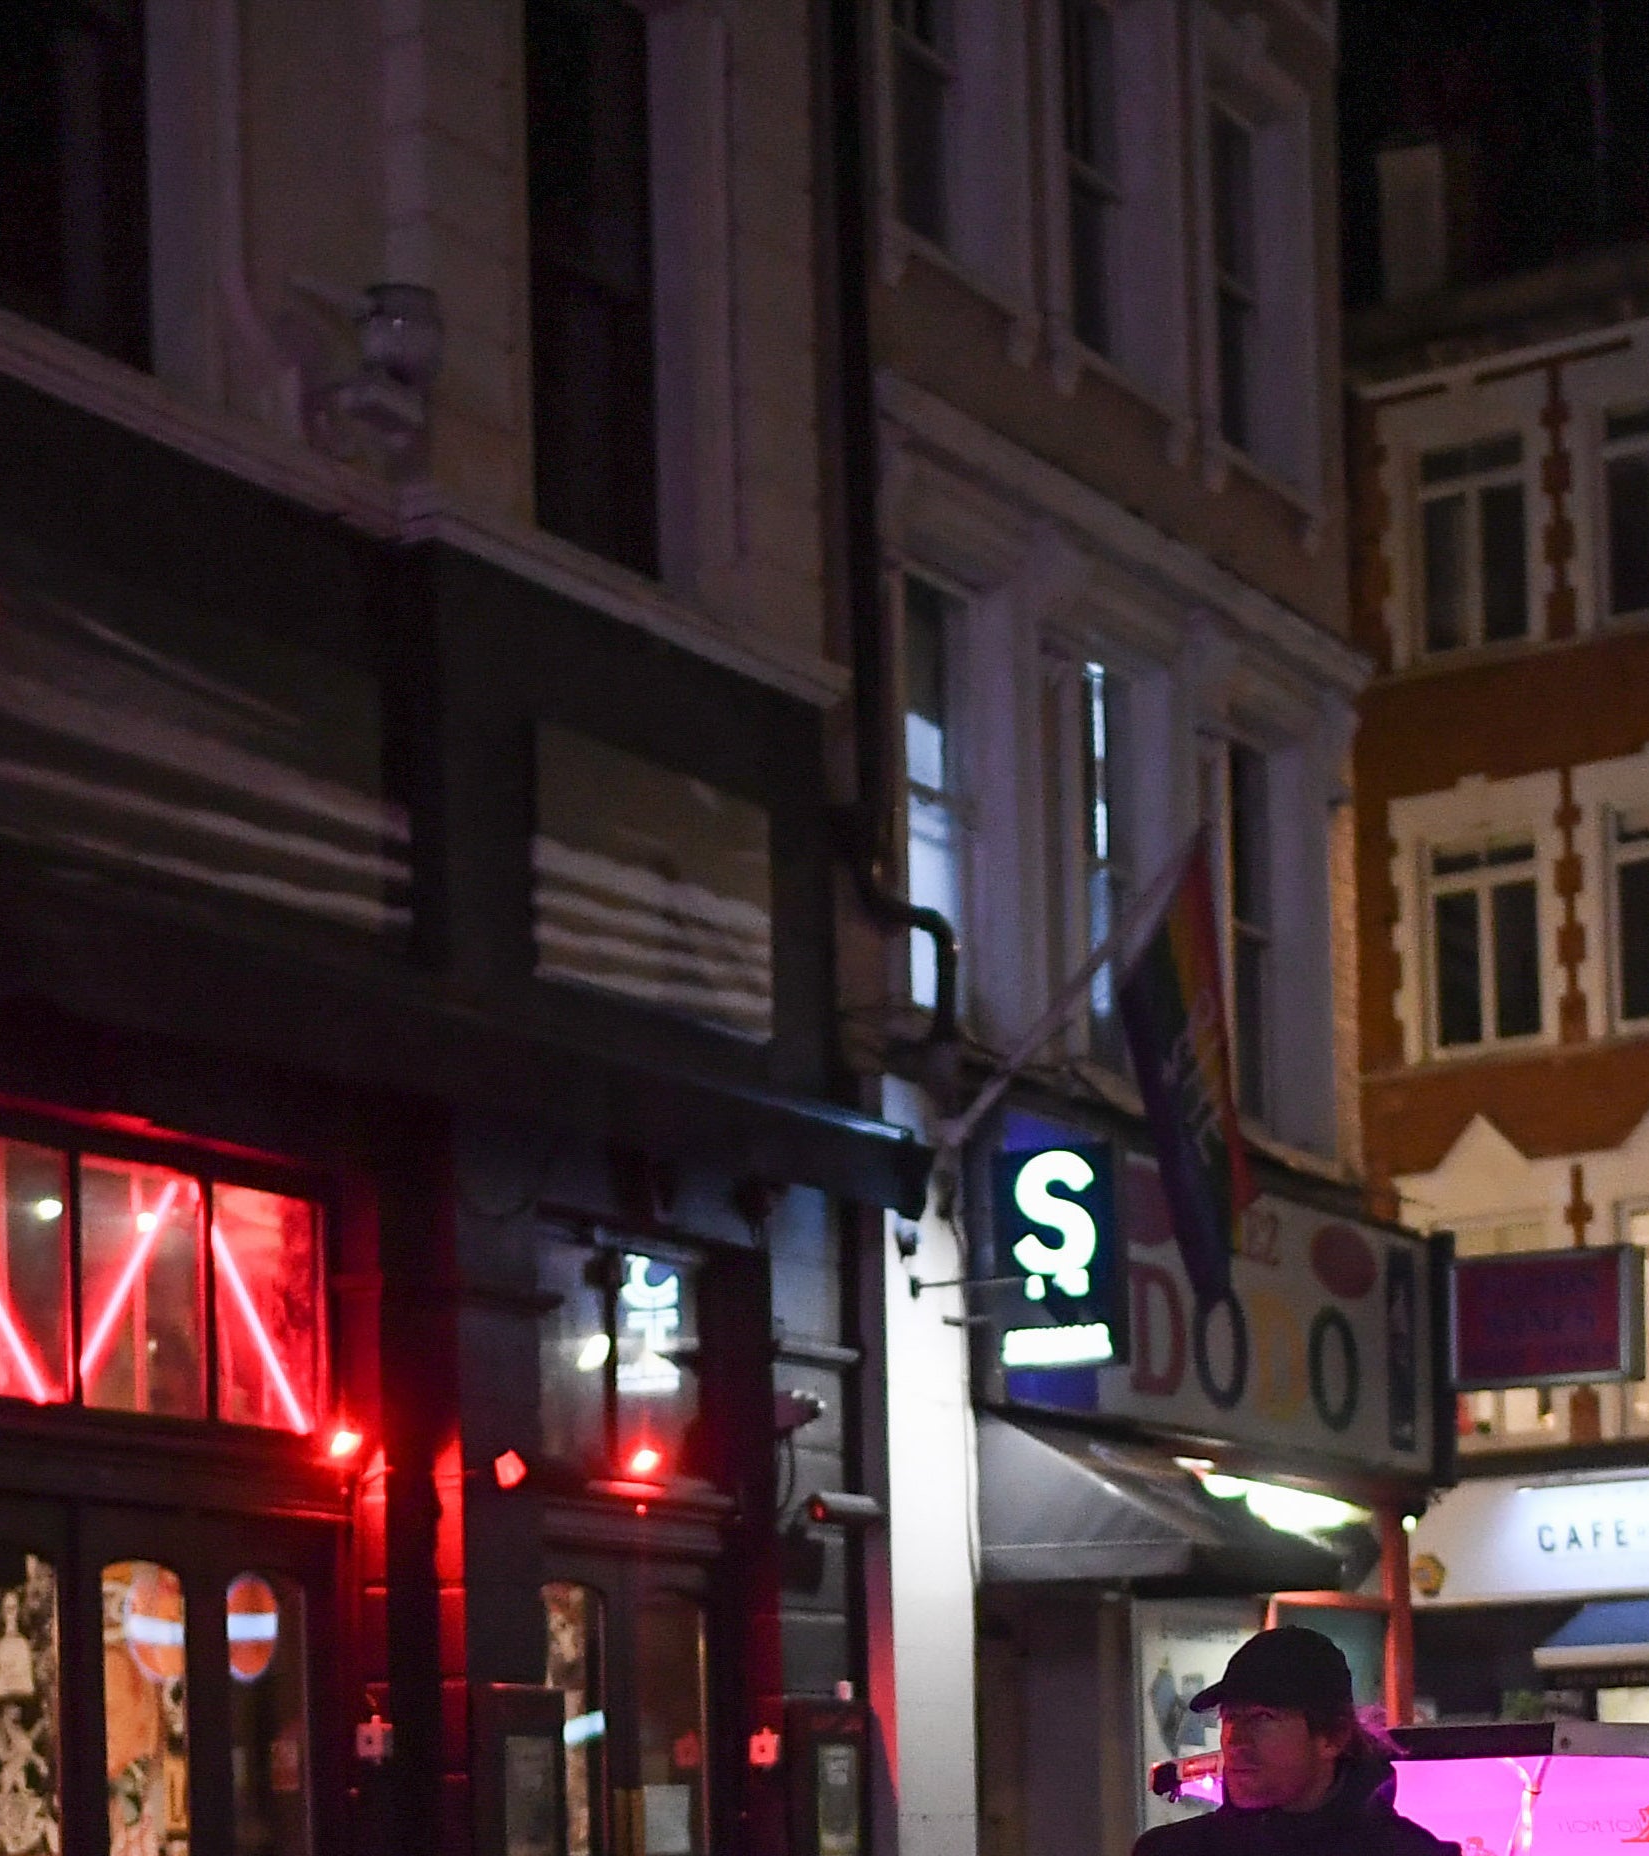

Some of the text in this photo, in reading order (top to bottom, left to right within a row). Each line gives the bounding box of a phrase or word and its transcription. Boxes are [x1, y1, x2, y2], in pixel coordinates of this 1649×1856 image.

[1129, 1258, 1360, 1434] DODO
[1537, 1520, 1628, 1552] CAFE
[1565, 1819, 1603, 1833] LOVE
